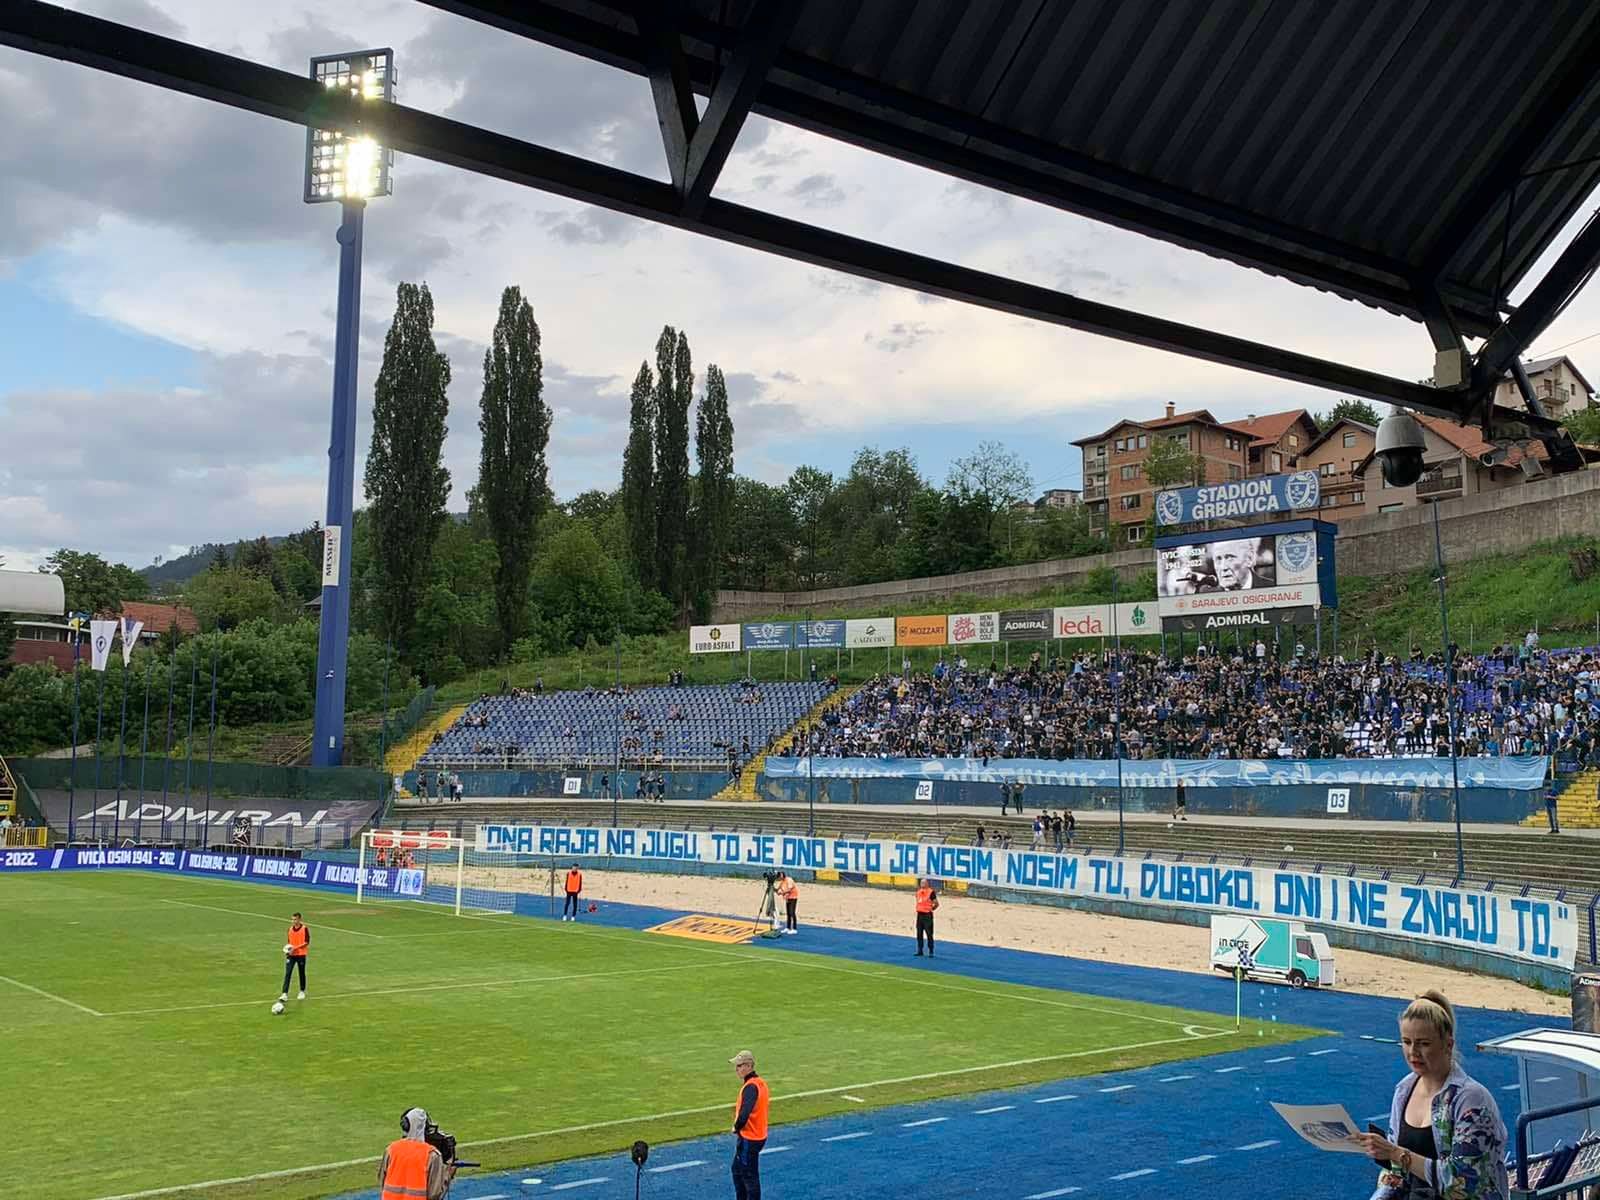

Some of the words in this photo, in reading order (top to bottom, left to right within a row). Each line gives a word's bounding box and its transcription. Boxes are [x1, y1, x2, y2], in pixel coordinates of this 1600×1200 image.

[1197, 480, 1272, 503] STADION
[1192, 495, 1279, 520] GRBAVICA
[325, 538, 333, 577] MESSER
[1192, 597, 1238, 609] SARAJEVO
[1242, 592, 1302, 604] OSIGURANJE
[1004, 620, 1048, 631] ADMIRAL
[1060, 615, 1103, 635] leda
[1206, 612, 1270, 628] ADMIRAL
[695, 642, 712, 651] EURO
[713, 641, 735, 650] ASFALT
[919, 784, 930, 796] 02
[1331, 793, 1346, 808] 03
[77, 800, 338, 829] ADMIRAL
[5, 852, 38, 866] 2022.
[77, 850, 106, 865] IVICA
[107, 850, 132, 864] OSIM
[132, 850, 153, 864] 1941
[539, 828, 600, 854] RAJA
[607, 829, 635, 856] NA
[712, 834, 740, 861] TO
[747, 835, 775, 864] JE
[782, 835, 827, 868] ONO
[890, 843, 918, 874] JA
[926, 846, 998, 881] NOSIM,
[1006, 853, 1079, 890] NOSIM
[1088, 859, 1130, 900] TU,
[1140, 863, 1260, 910] DUBOKO.
[1274, 873, 1321, 919] ONI
[1349, 879, 1387, 928] NE
[1400, 887, 1497, 945] ZNAJU
